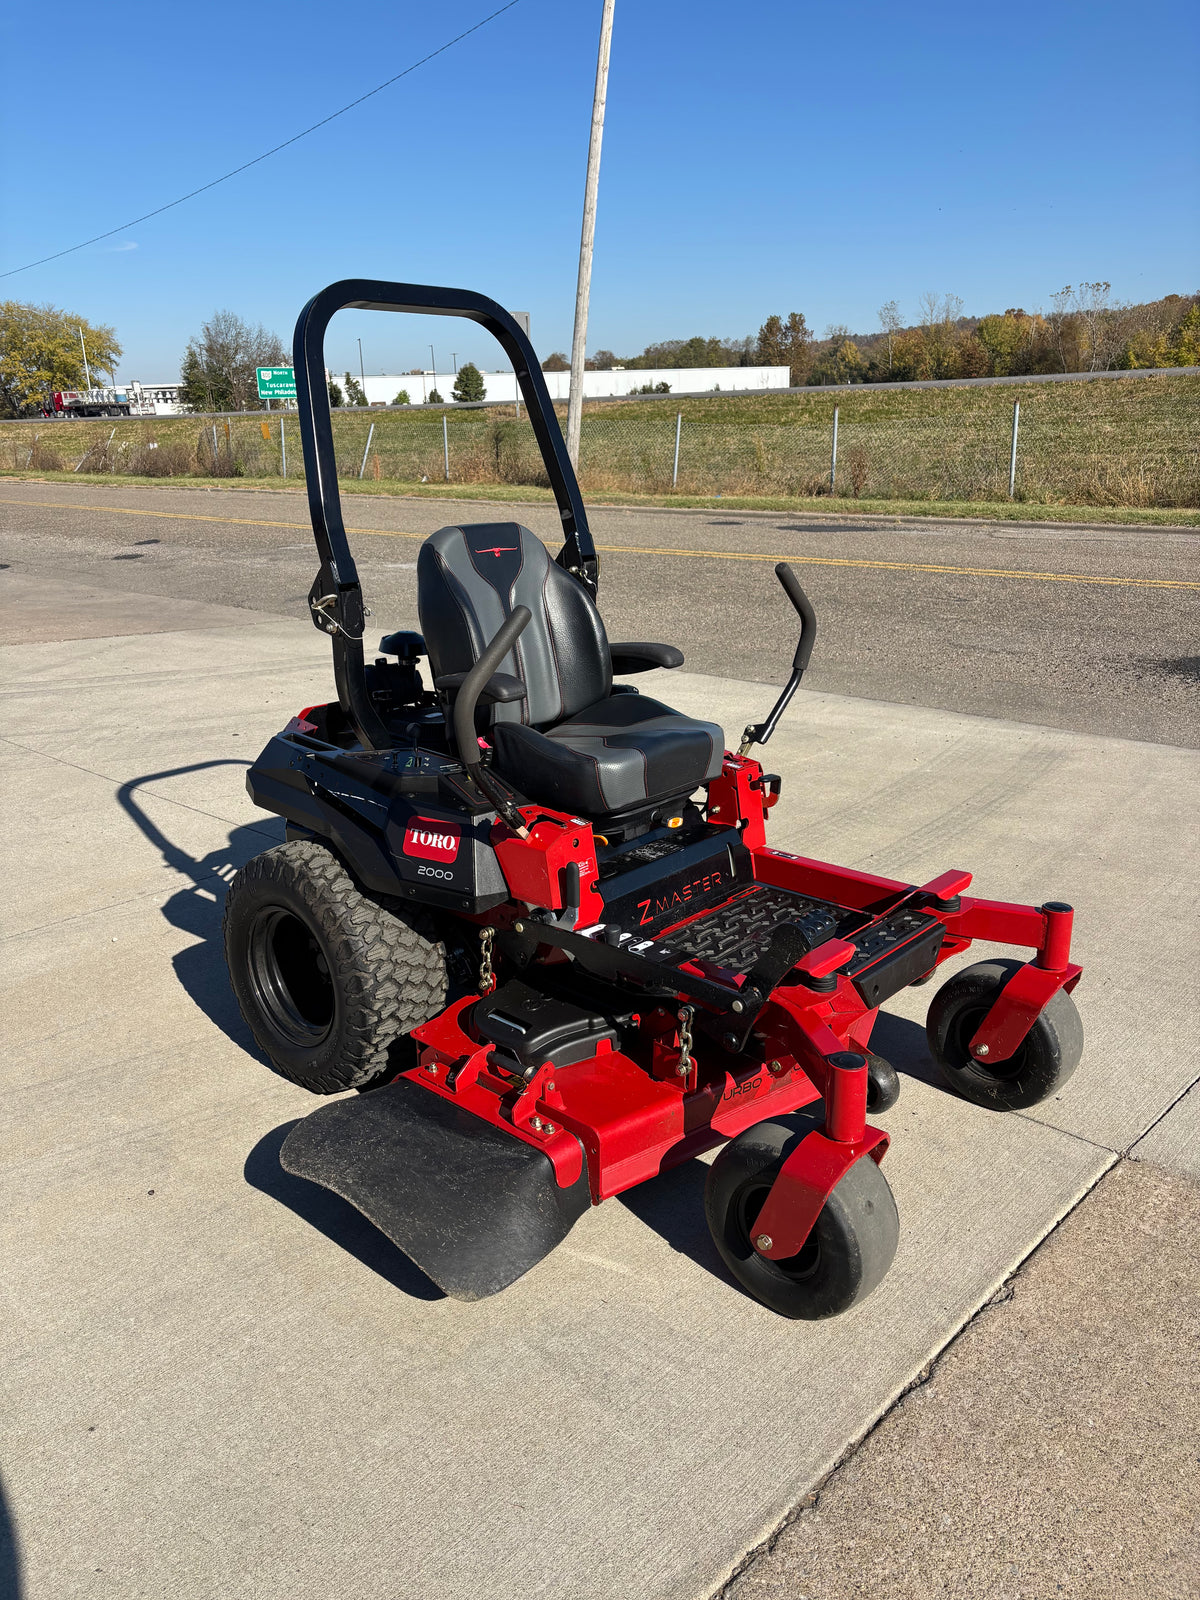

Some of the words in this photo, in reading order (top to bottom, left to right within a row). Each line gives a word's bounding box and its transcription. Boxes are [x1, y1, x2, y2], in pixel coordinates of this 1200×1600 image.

[410, 828, 456, 850] TORO
[417, 865, 454, 881] 2000
[655, 872, 722, 914] MASTER
[723, 1077, 762, 1101] URBO
